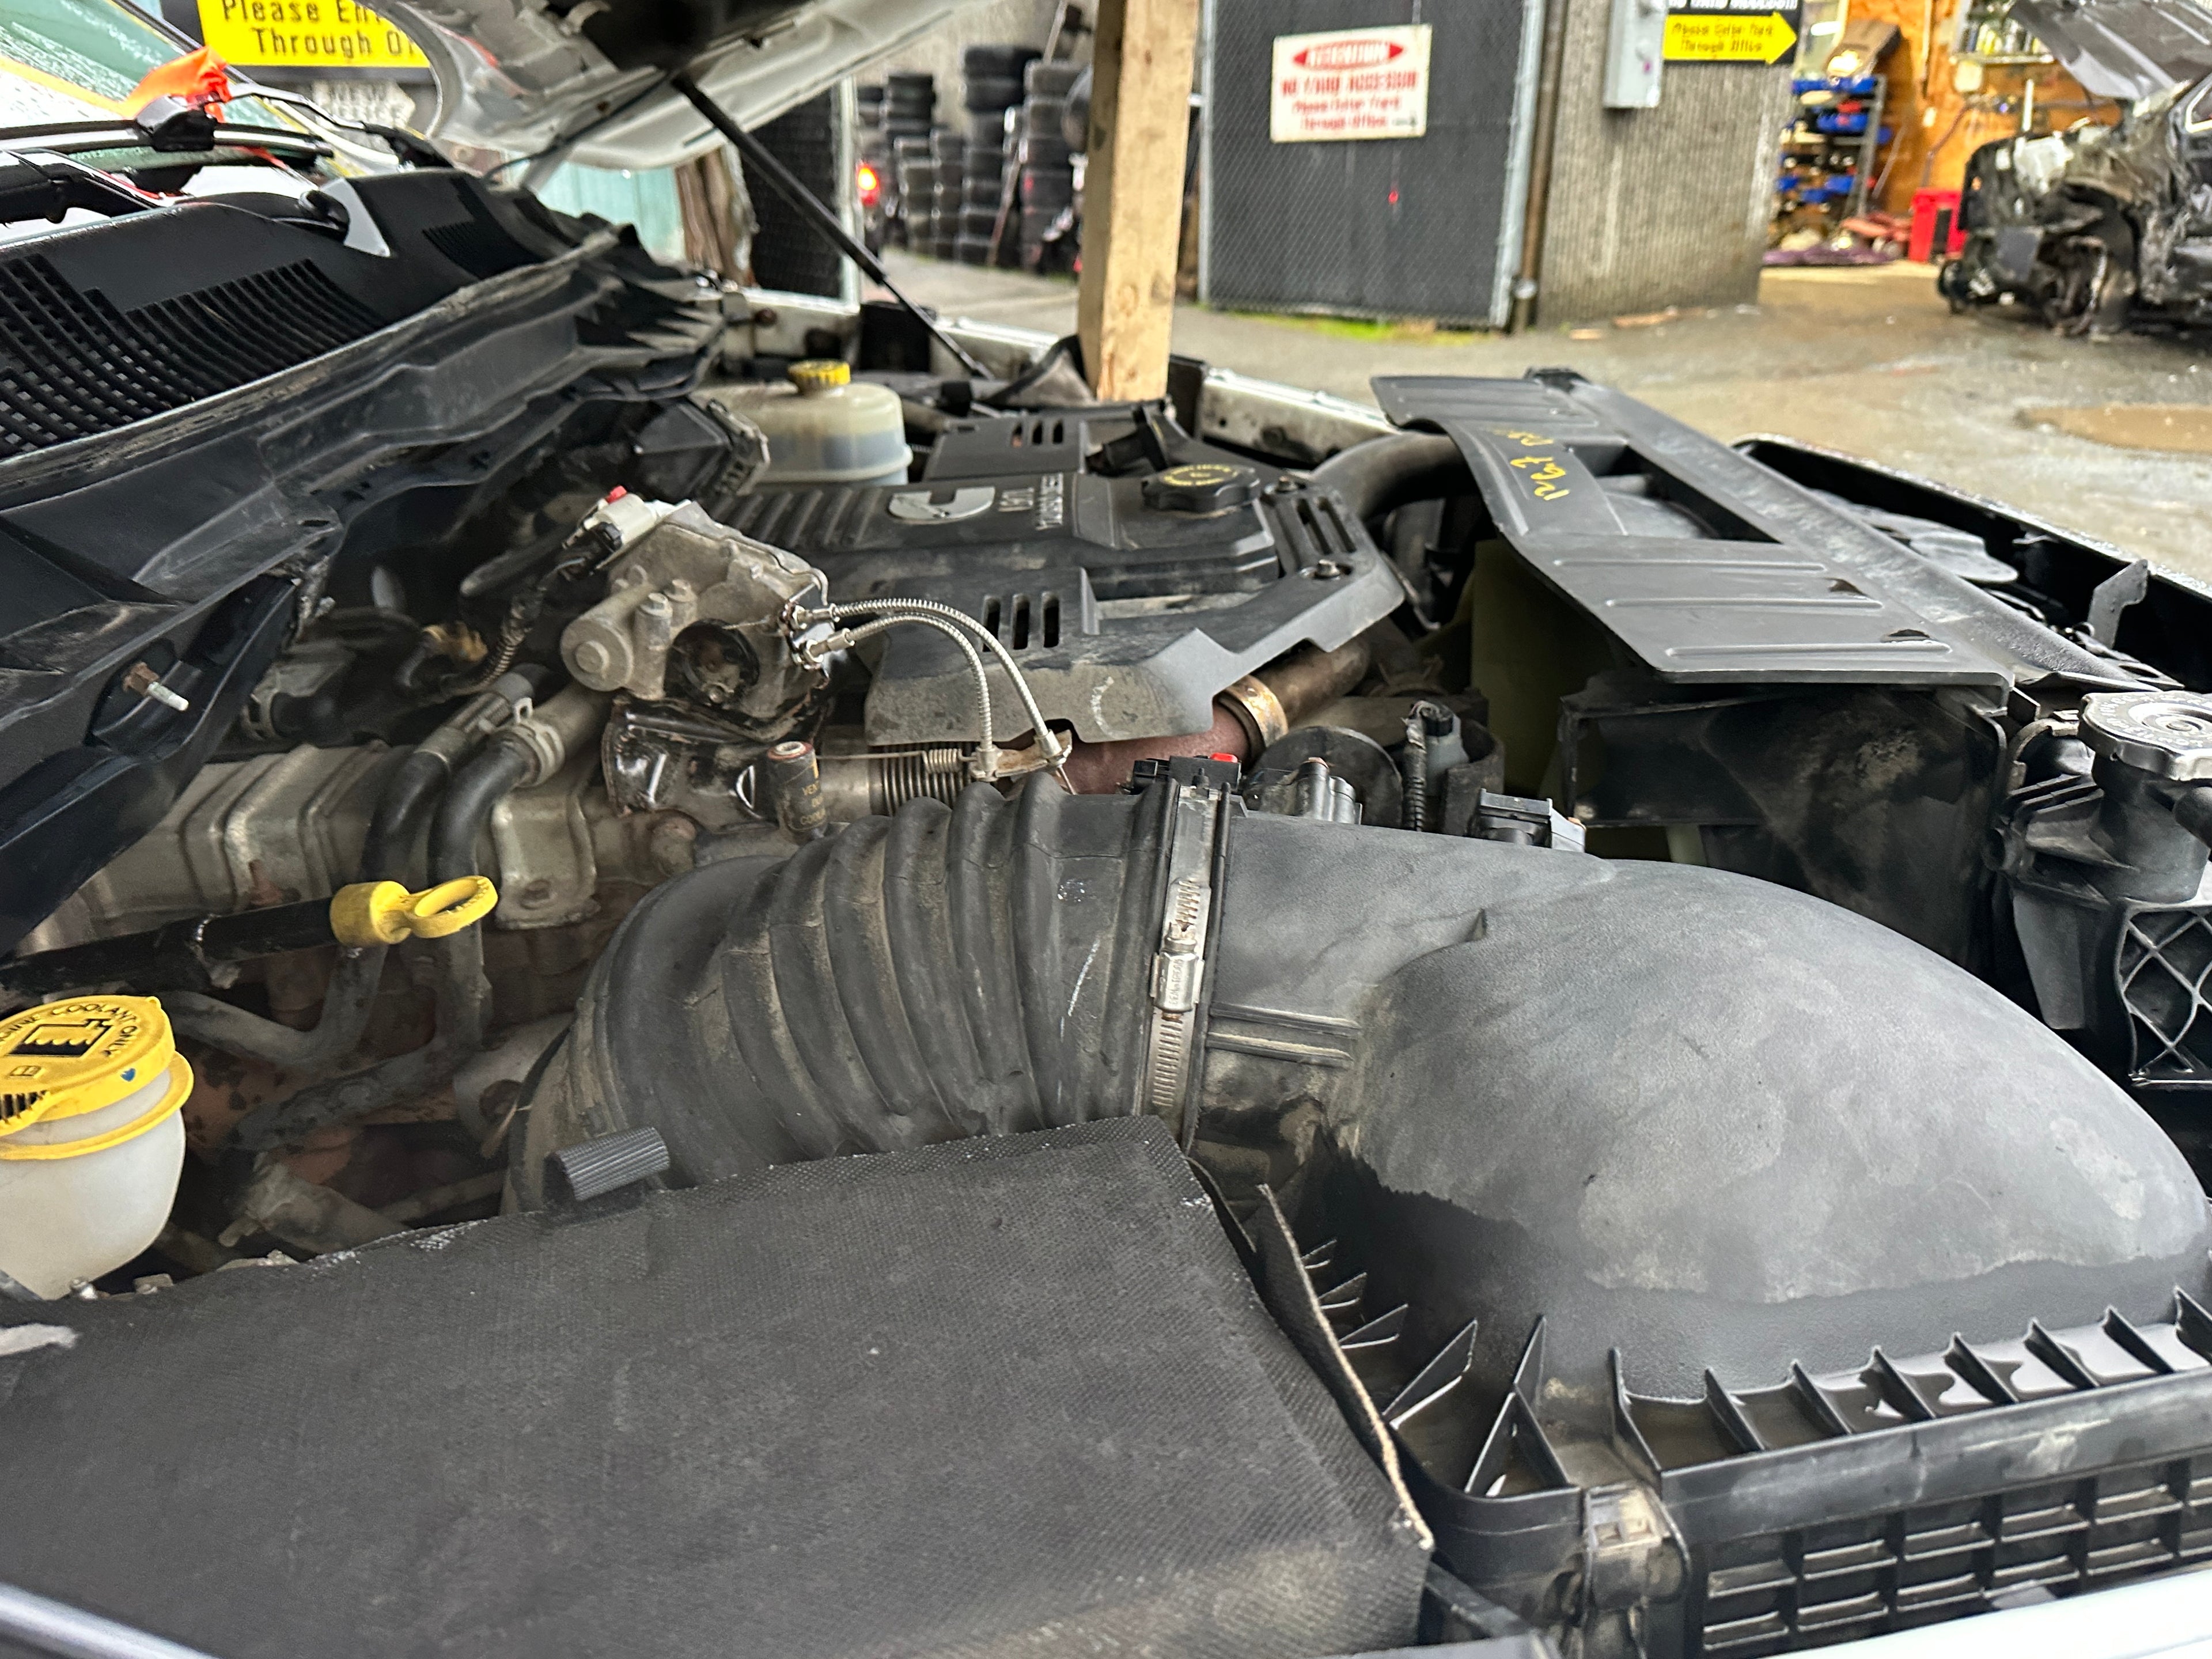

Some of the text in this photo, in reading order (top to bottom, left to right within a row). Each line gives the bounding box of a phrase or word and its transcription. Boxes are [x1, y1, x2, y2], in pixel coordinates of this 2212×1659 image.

[223, 0, 381, 24] Please En
[252, 27, 372, 59] Through
[51, 1003, 138, 1024] COOLANT
